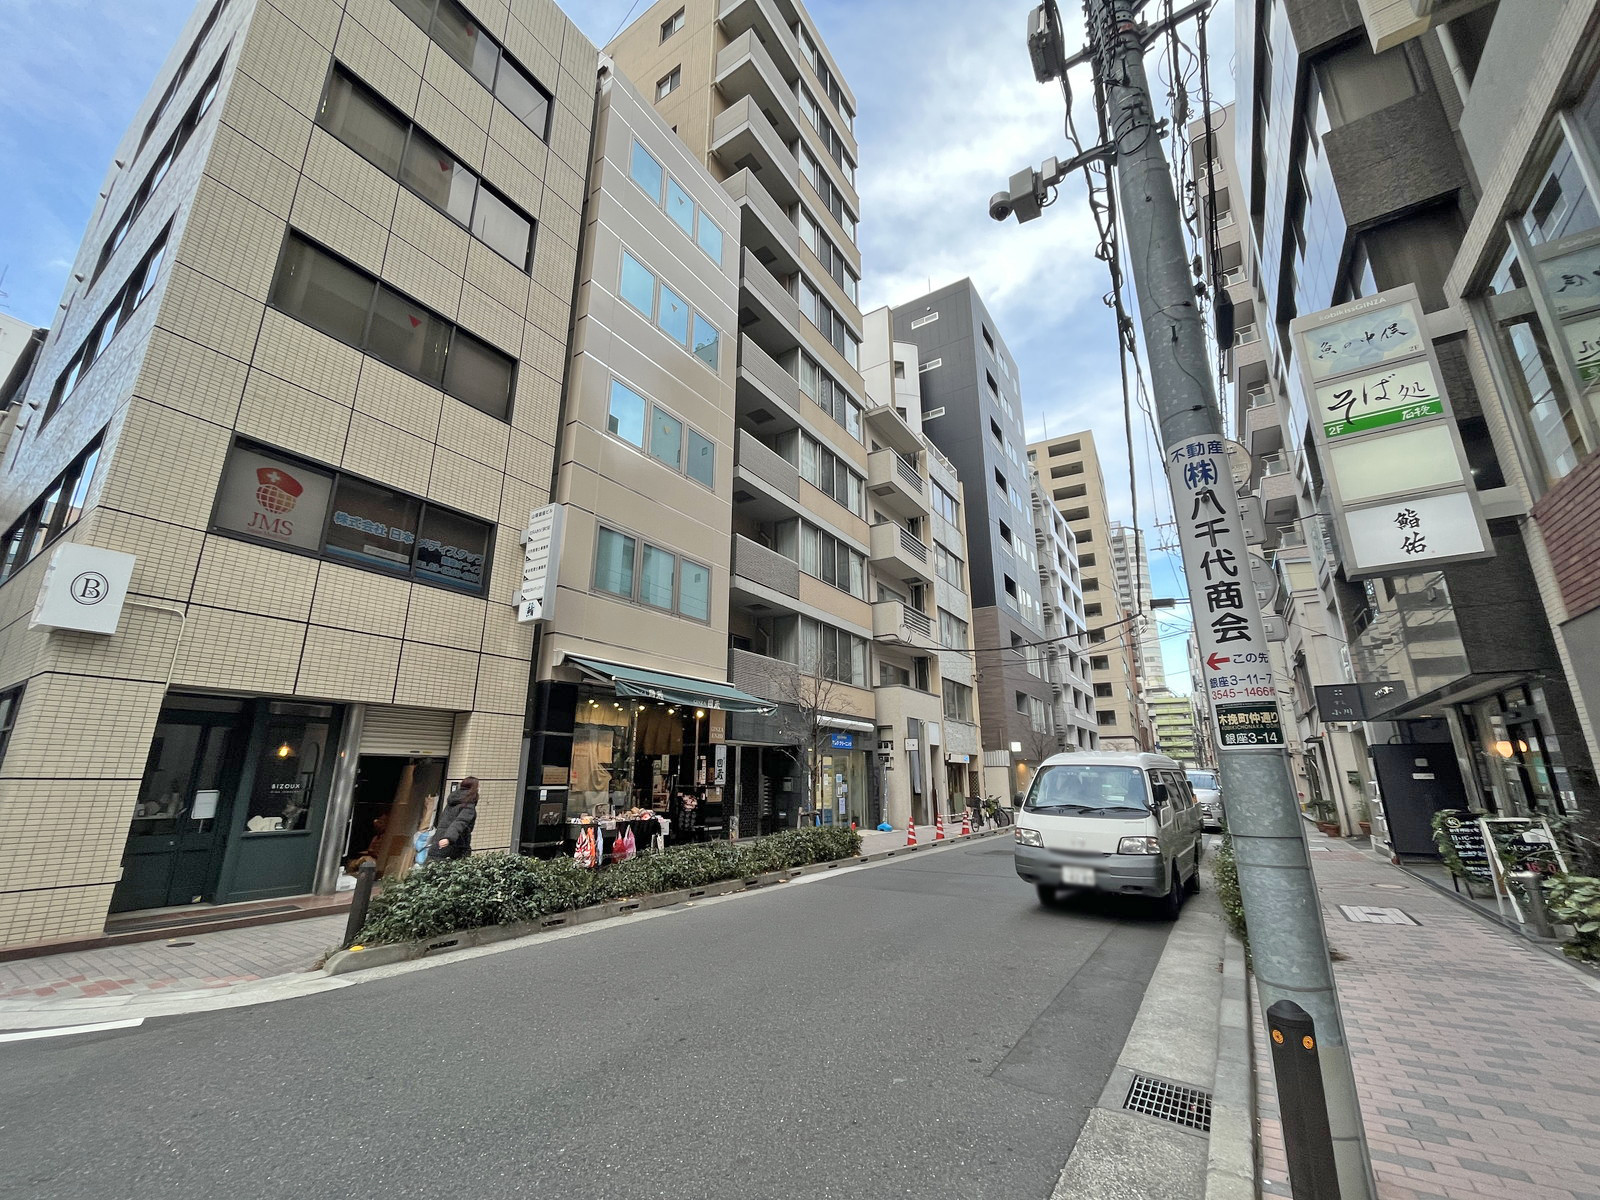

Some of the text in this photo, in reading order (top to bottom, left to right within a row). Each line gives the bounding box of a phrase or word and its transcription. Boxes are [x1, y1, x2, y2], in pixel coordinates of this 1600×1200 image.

[1327, 373, 1431, 426] そば処
[1328, 424, 1345, 436] 2F
[1171, 440, 1223, 463] 不動産
[247, 511, 294, 536] JMS
[1233, 653, 1269, 664] この先
[1210, 674, 1272, 688] 銀座3-11-7
[1219, 712, 1278, 725] 木挽町仲通り
[1225, 732, 1278, 745] 銀座3-14
